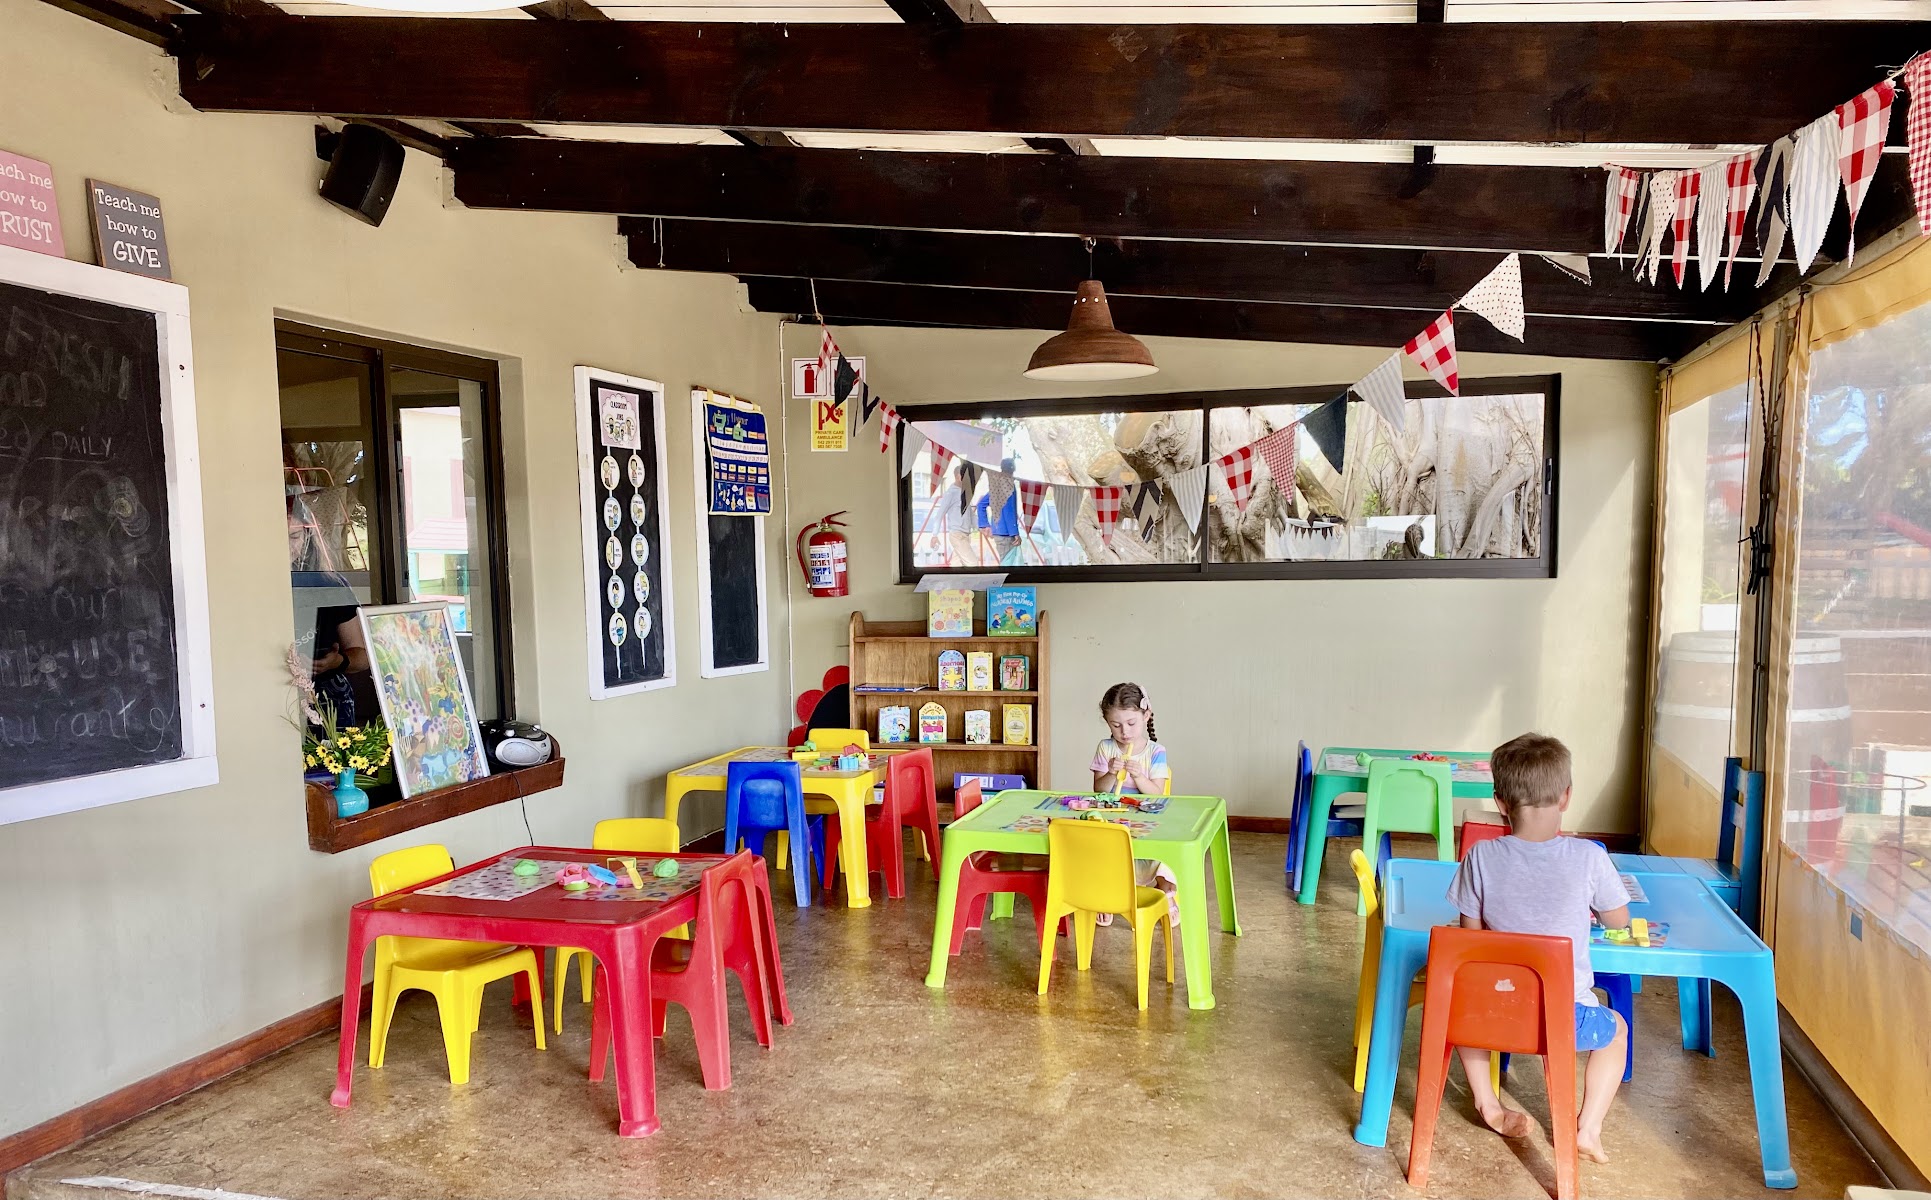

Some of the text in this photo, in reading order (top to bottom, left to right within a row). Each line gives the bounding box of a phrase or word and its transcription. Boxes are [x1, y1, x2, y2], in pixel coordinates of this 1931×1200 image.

[29, 172, 52, 189] me
[30, 195, 47, 212] to
[95, 188, 160, 218] Teach me
[105, 214, 157, 240] how to
[112, 240, 161, 268] GIVE
